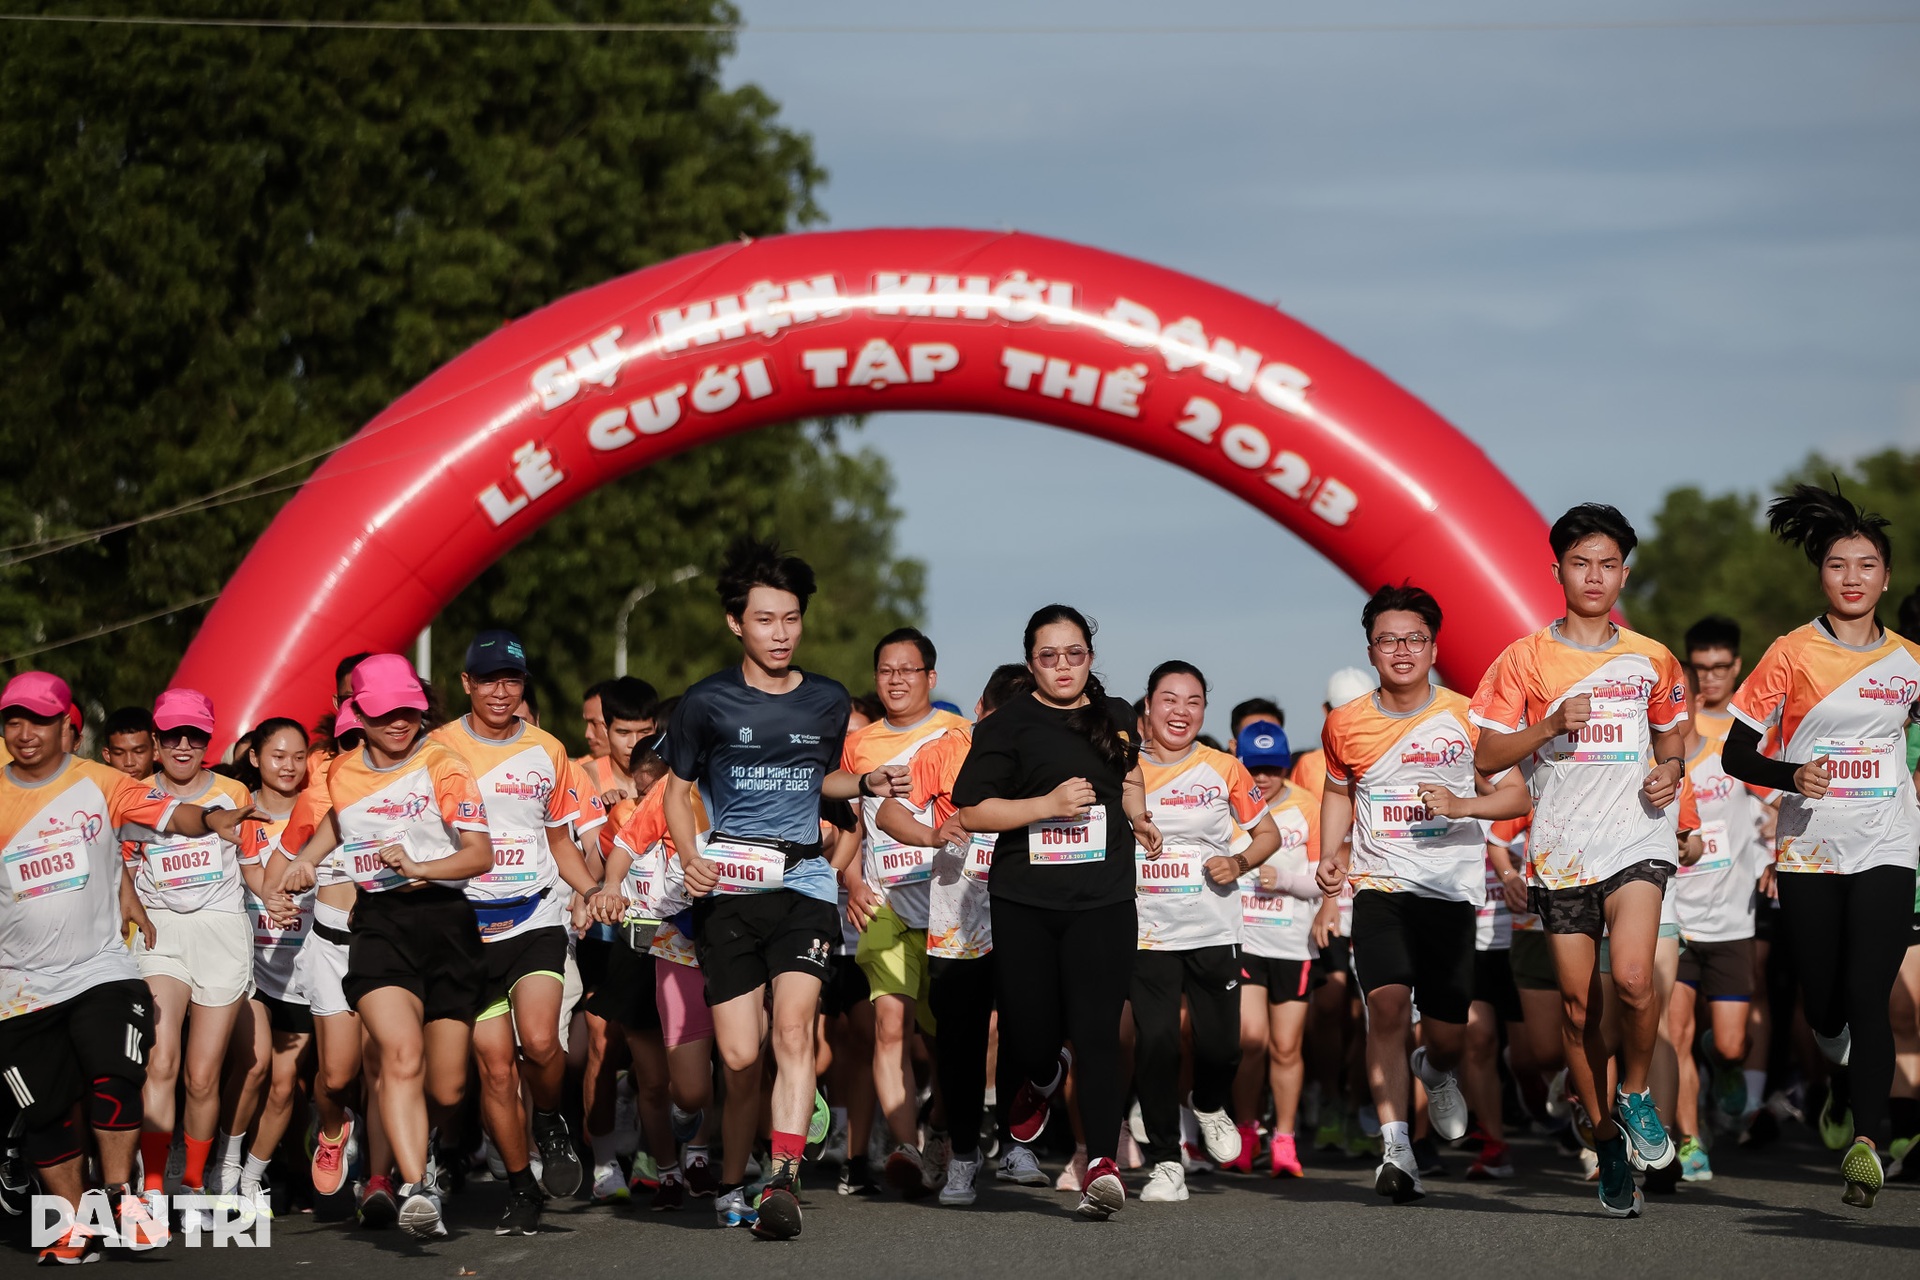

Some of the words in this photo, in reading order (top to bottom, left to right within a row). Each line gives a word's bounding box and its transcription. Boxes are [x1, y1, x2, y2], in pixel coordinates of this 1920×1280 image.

[531, 326, 624, 411] SỰ
[874, 270, 1074, 326] KHỞI
[1104, 297, 1312, 416] ĐỘNG
[479, 440, 564, 527] LỄ
[587, 357, 774, 450] CƯỚI
[803, 338, 960, 390] TẬP
[1001, 347, 1150, 418] THỂ
[1175, 396, 1359, 527] 2023
[1859, 687, 1884, 700] Couple
[1884, 687, 1899, 699] Run
[731, 766, 745, 778] HO
[748, 766, 764, 778] CHI
[767, 767, 790, 778] MINH
[793, 767, 814, 779] CITY
[1826, 759, 1879, 779] R0091
[736, 778, 782, 790] MIDNIGHT
[785, 780, 809, 791] 2023
[1042, 826, 1089, 845] R0161
[19, 852, 76, 881] R0033
[162, 851, 210, 873] R0032
[883, 850, 923, 870] R0158
[716, 861, 764, 882] R0161
[1142, 862, 1189, 879] R0004
[1241, 895, 1284, 912] R0029
